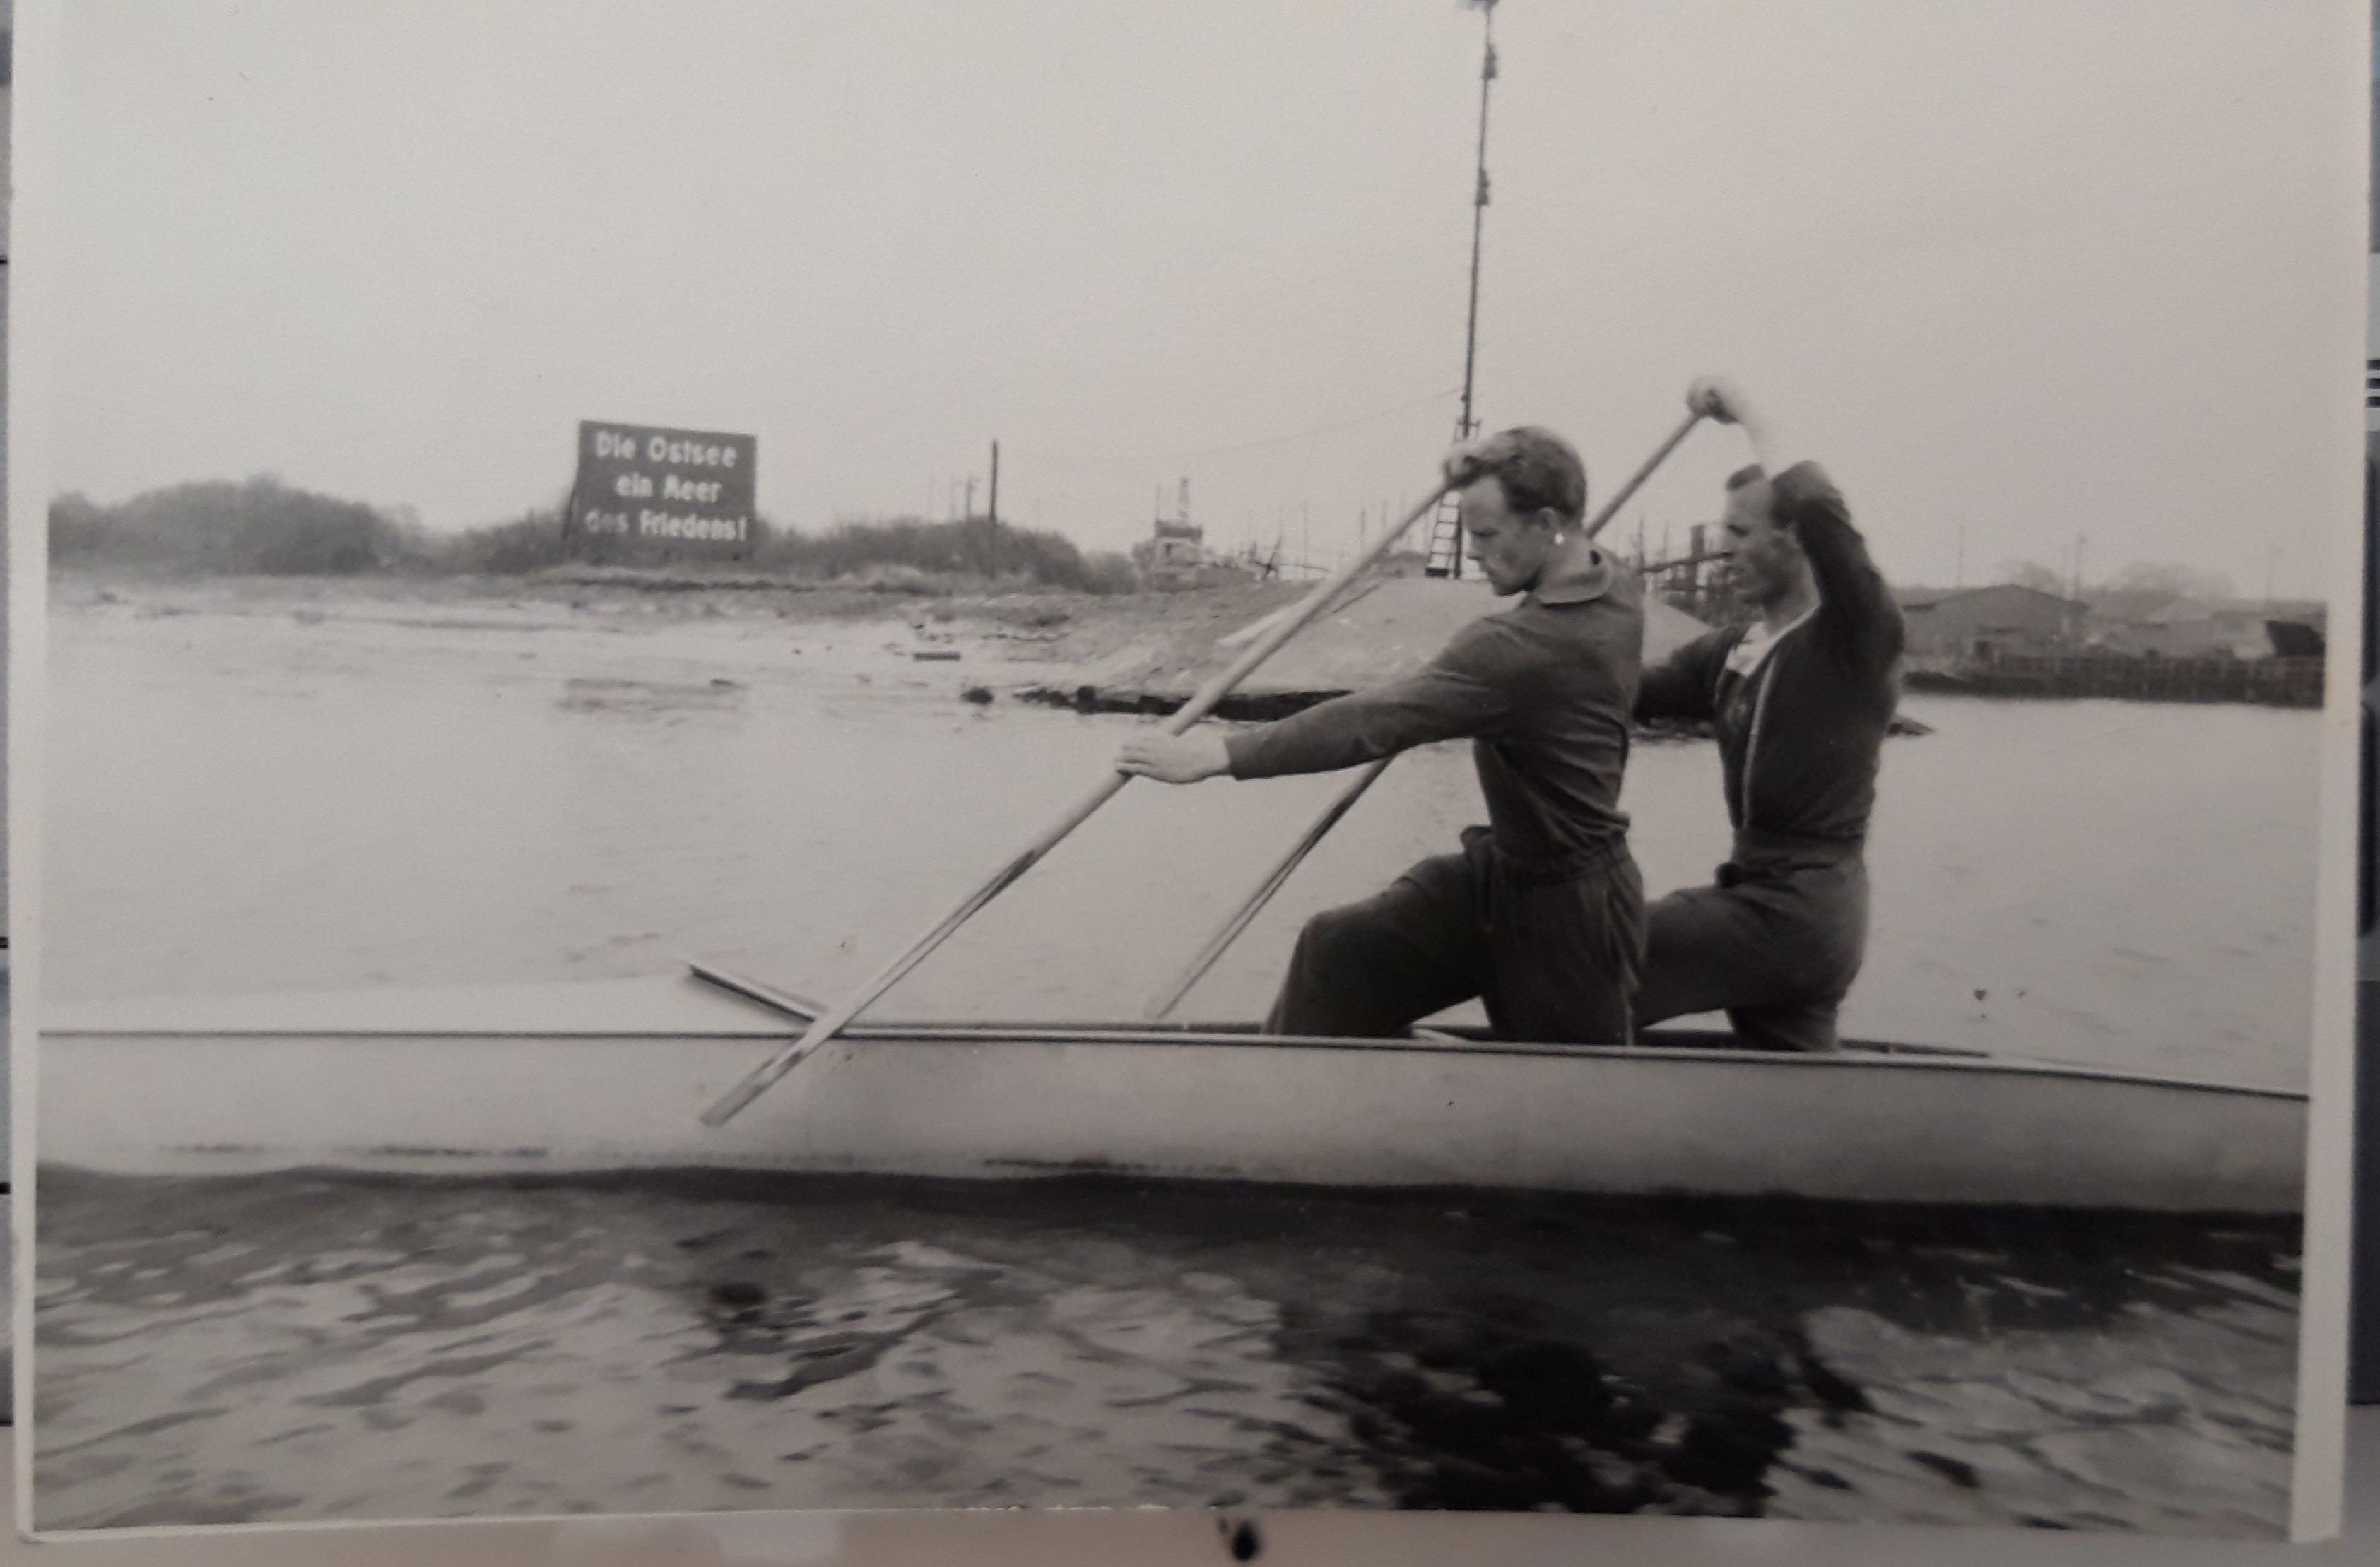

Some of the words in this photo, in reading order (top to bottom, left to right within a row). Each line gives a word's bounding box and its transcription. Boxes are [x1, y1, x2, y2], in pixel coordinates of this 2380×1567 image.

[596, 430, 636, 459] Die
[648, 435, 738, 468] Ostsee
[616, 472, 653, 498] ein
